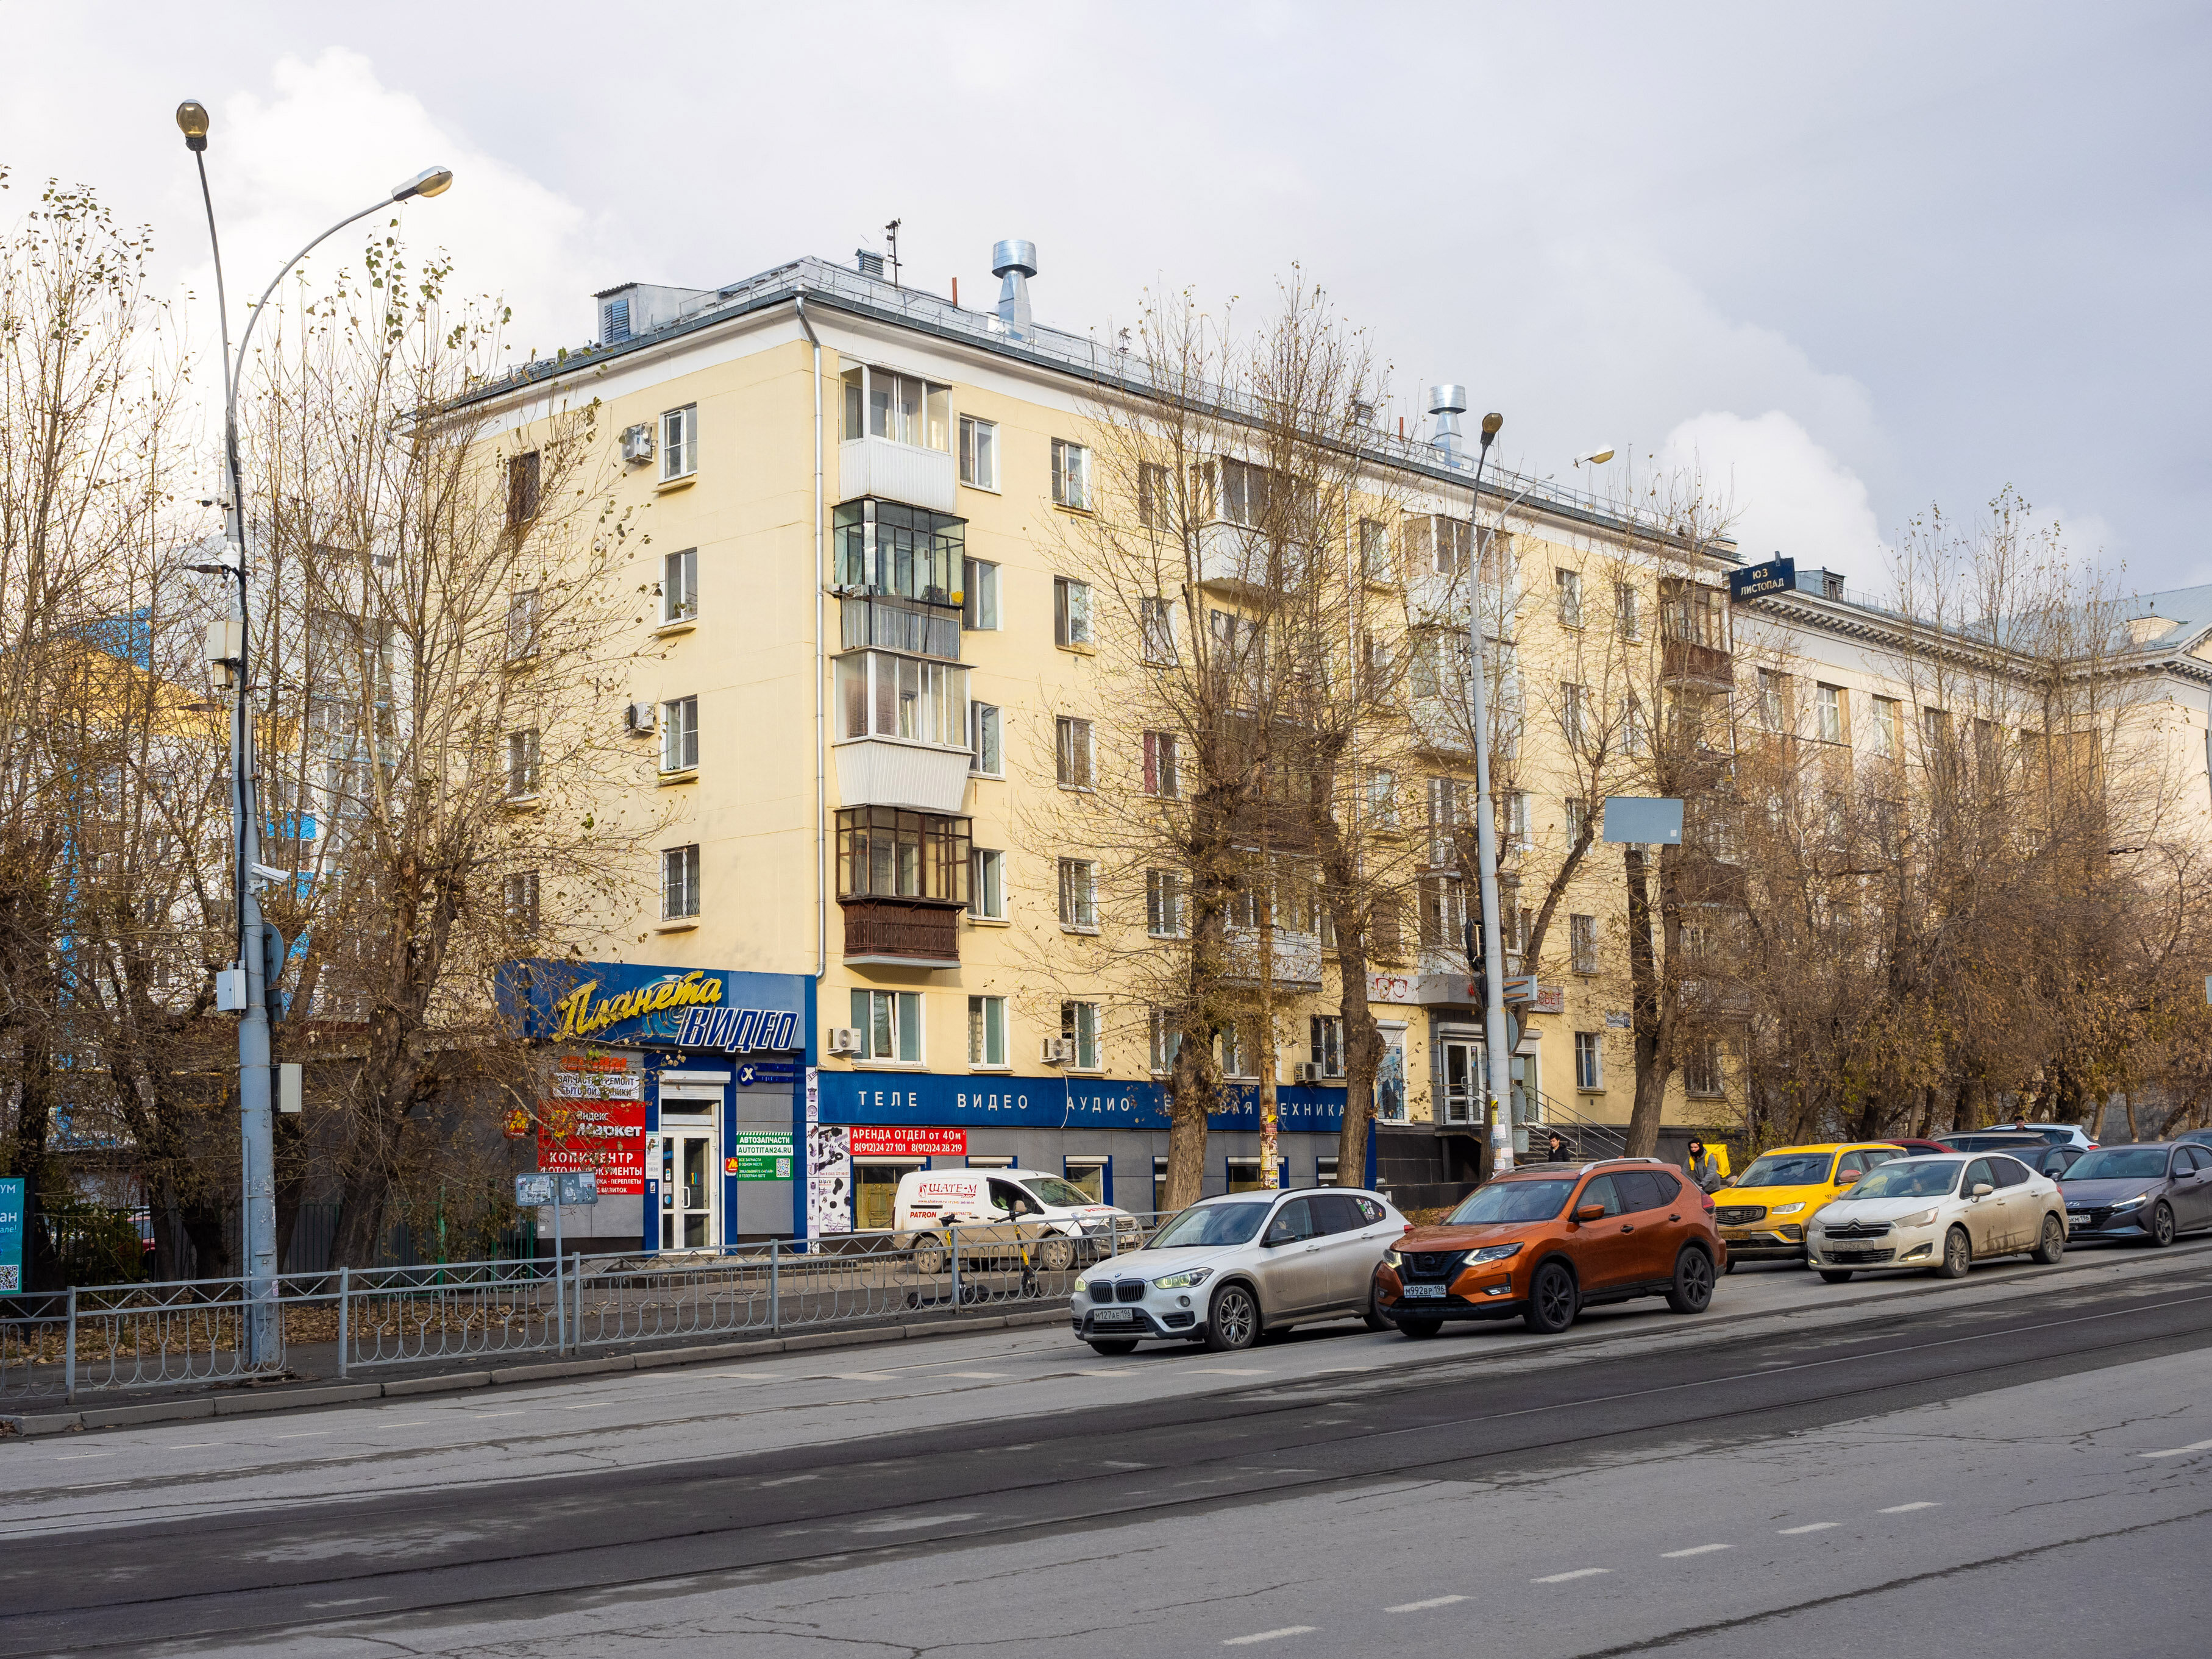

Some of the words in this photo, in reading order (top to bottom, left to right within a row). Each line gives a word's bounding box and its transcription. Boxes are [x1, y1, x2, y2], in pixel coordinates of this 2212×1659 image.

[1740, 578, 1784, 595] ЛИСТОПАД
[556, 970, 722, 1035] Планета
[675, 1006, 799, 1053] ВИДЕО
[558, 1075, 597, 1084] ЗАПЧАСТ
[605, 1077, 635, 1085] РЕМОНТ
[859, 1091, 917, 1107] ТЕЛЕ
[957, 1093, 1028, 1111] ВИДЕО
[1067, 1096, 1129, 1114] АУДИО
[1280, 1103, 1345, 1117] ЕХНИКА
[852, 1129, 891, 1141] АРЕНДА
[894, 1130, 926, 1142] ОТДЕЛ
[854, 1143, 884, 1153] 8(912)24
[911, 1144, 941, 1153] 8(912)24
[550, 1152, 633, 1163] КОПИЕНТР
[1406, 1286, 1432, 1295] М992ВР
[1095, 1311, 1120, 1320] М127АЕ
